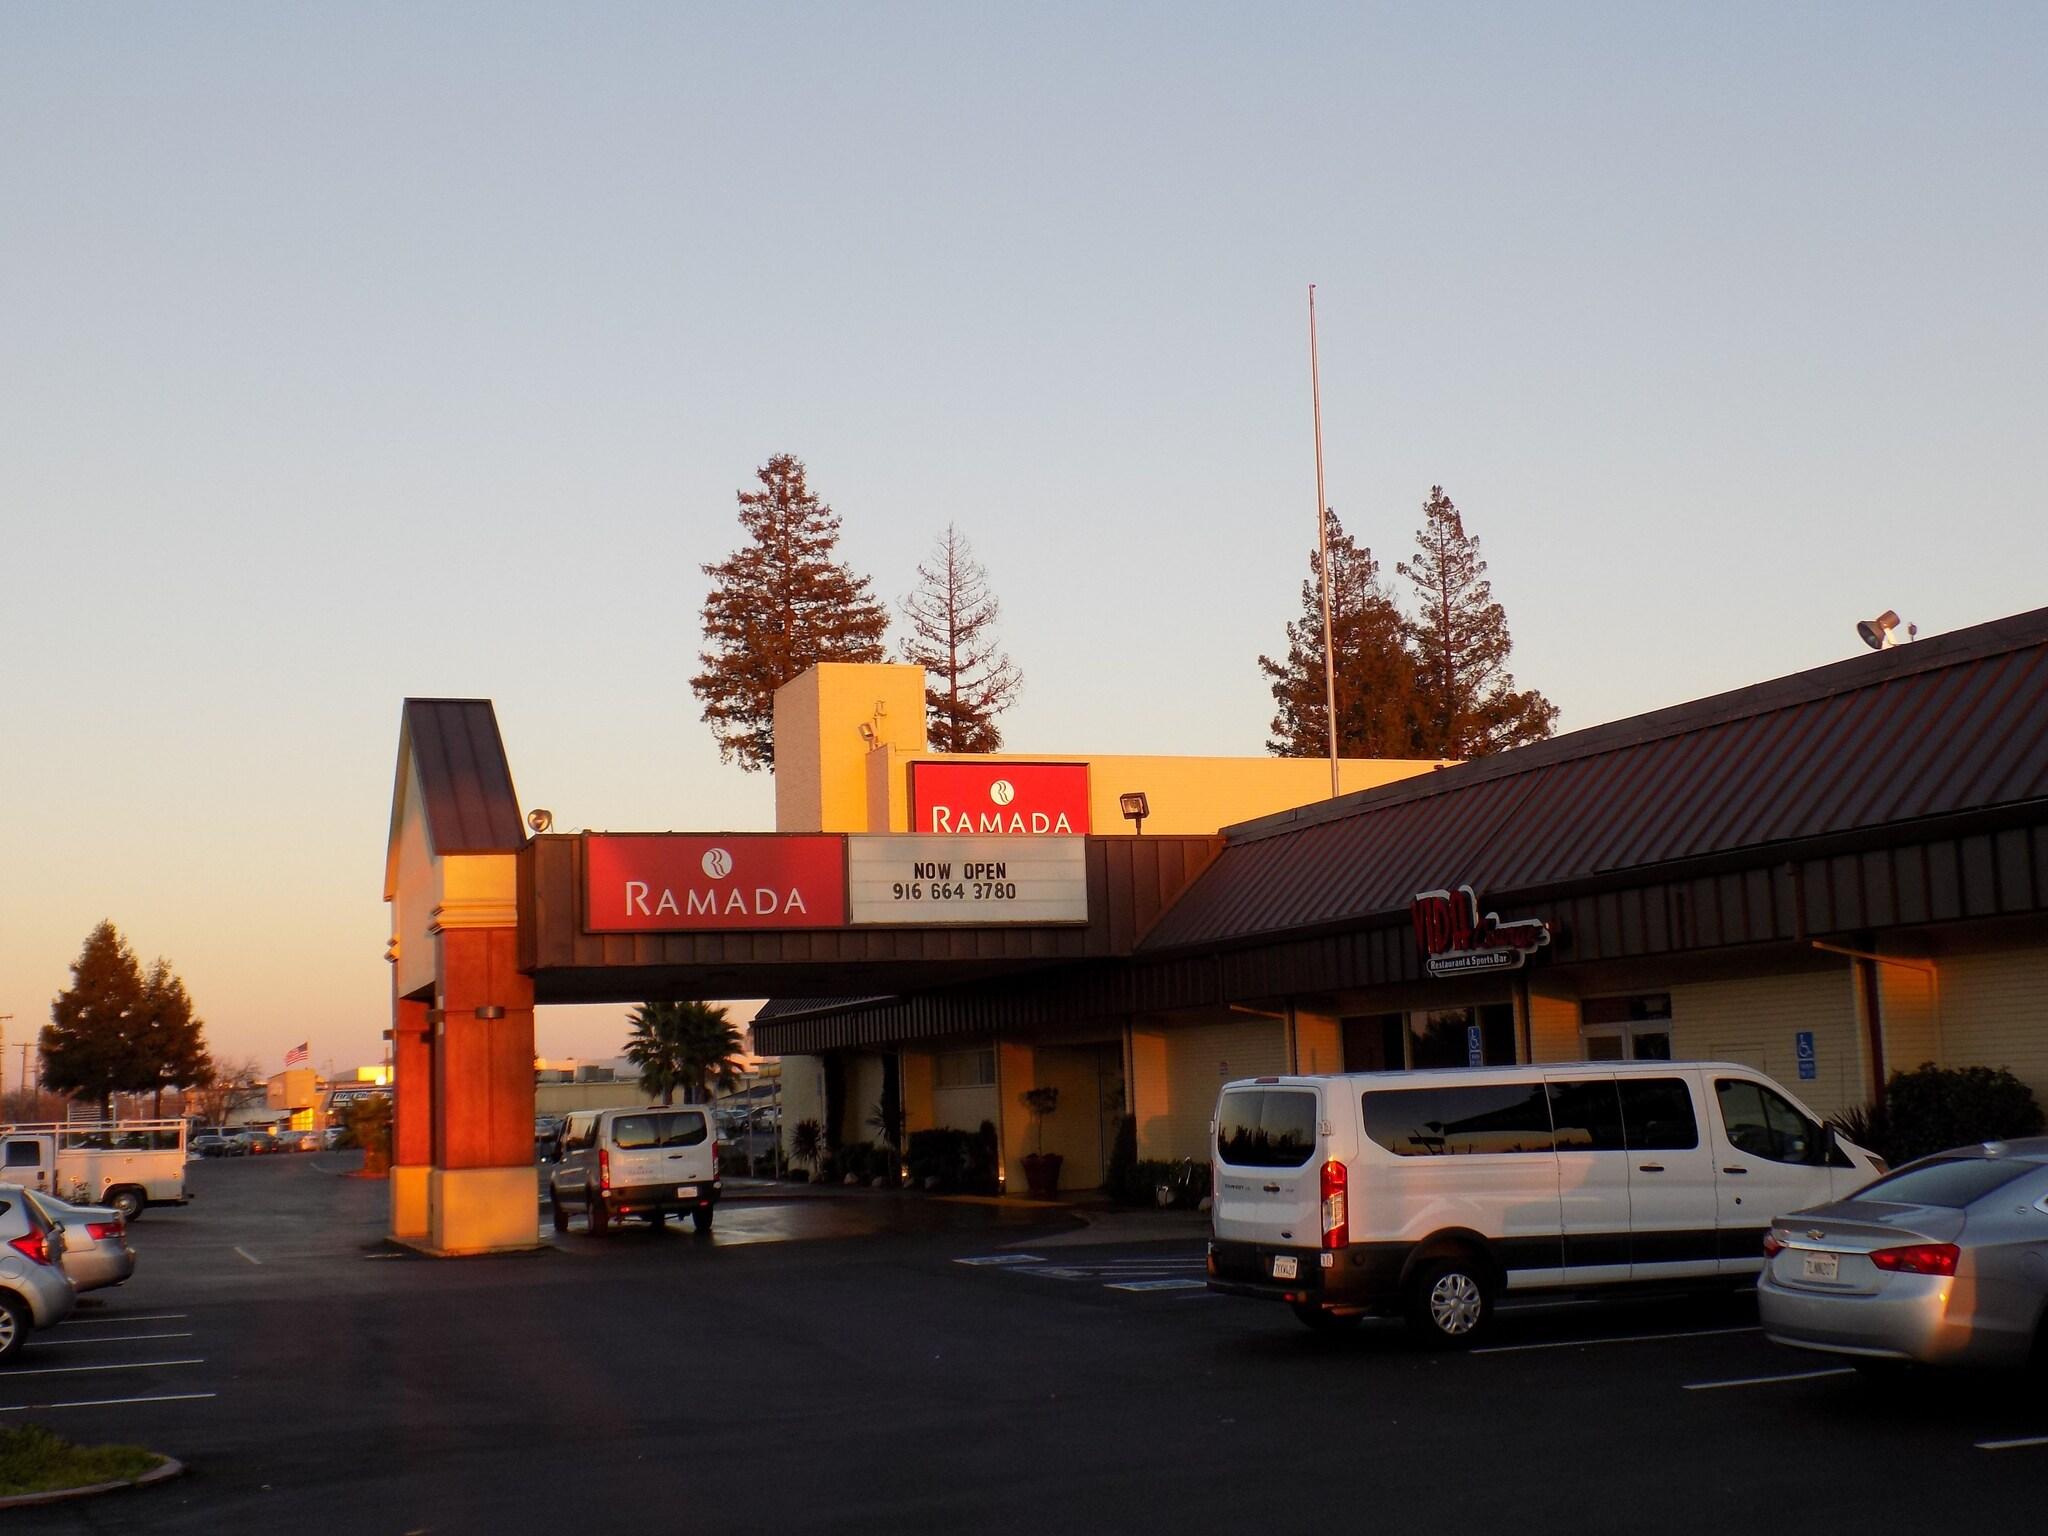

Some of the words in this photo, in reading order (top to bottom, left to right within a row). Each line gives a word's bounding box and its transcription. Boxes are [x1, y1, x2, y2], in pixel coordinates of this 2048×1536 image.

[932, 806, 1073, 833] RAMADA
[914, 862, 951, 879] NOW
[964, 862, 1006, 879] OPEN
[625, 881, 807, 916] RAMADA
[893, 883, 922, 900] 916
[931, 883, 965, 900] 664
[974, 883, 1016, 899] 3780
[1430, 957, 1465, 970] Restaurant
[1466, 957, 1471, 966] &
[1471, 955, 1494, 966] Sports
[1494, 953, 1508, 964] Bar
